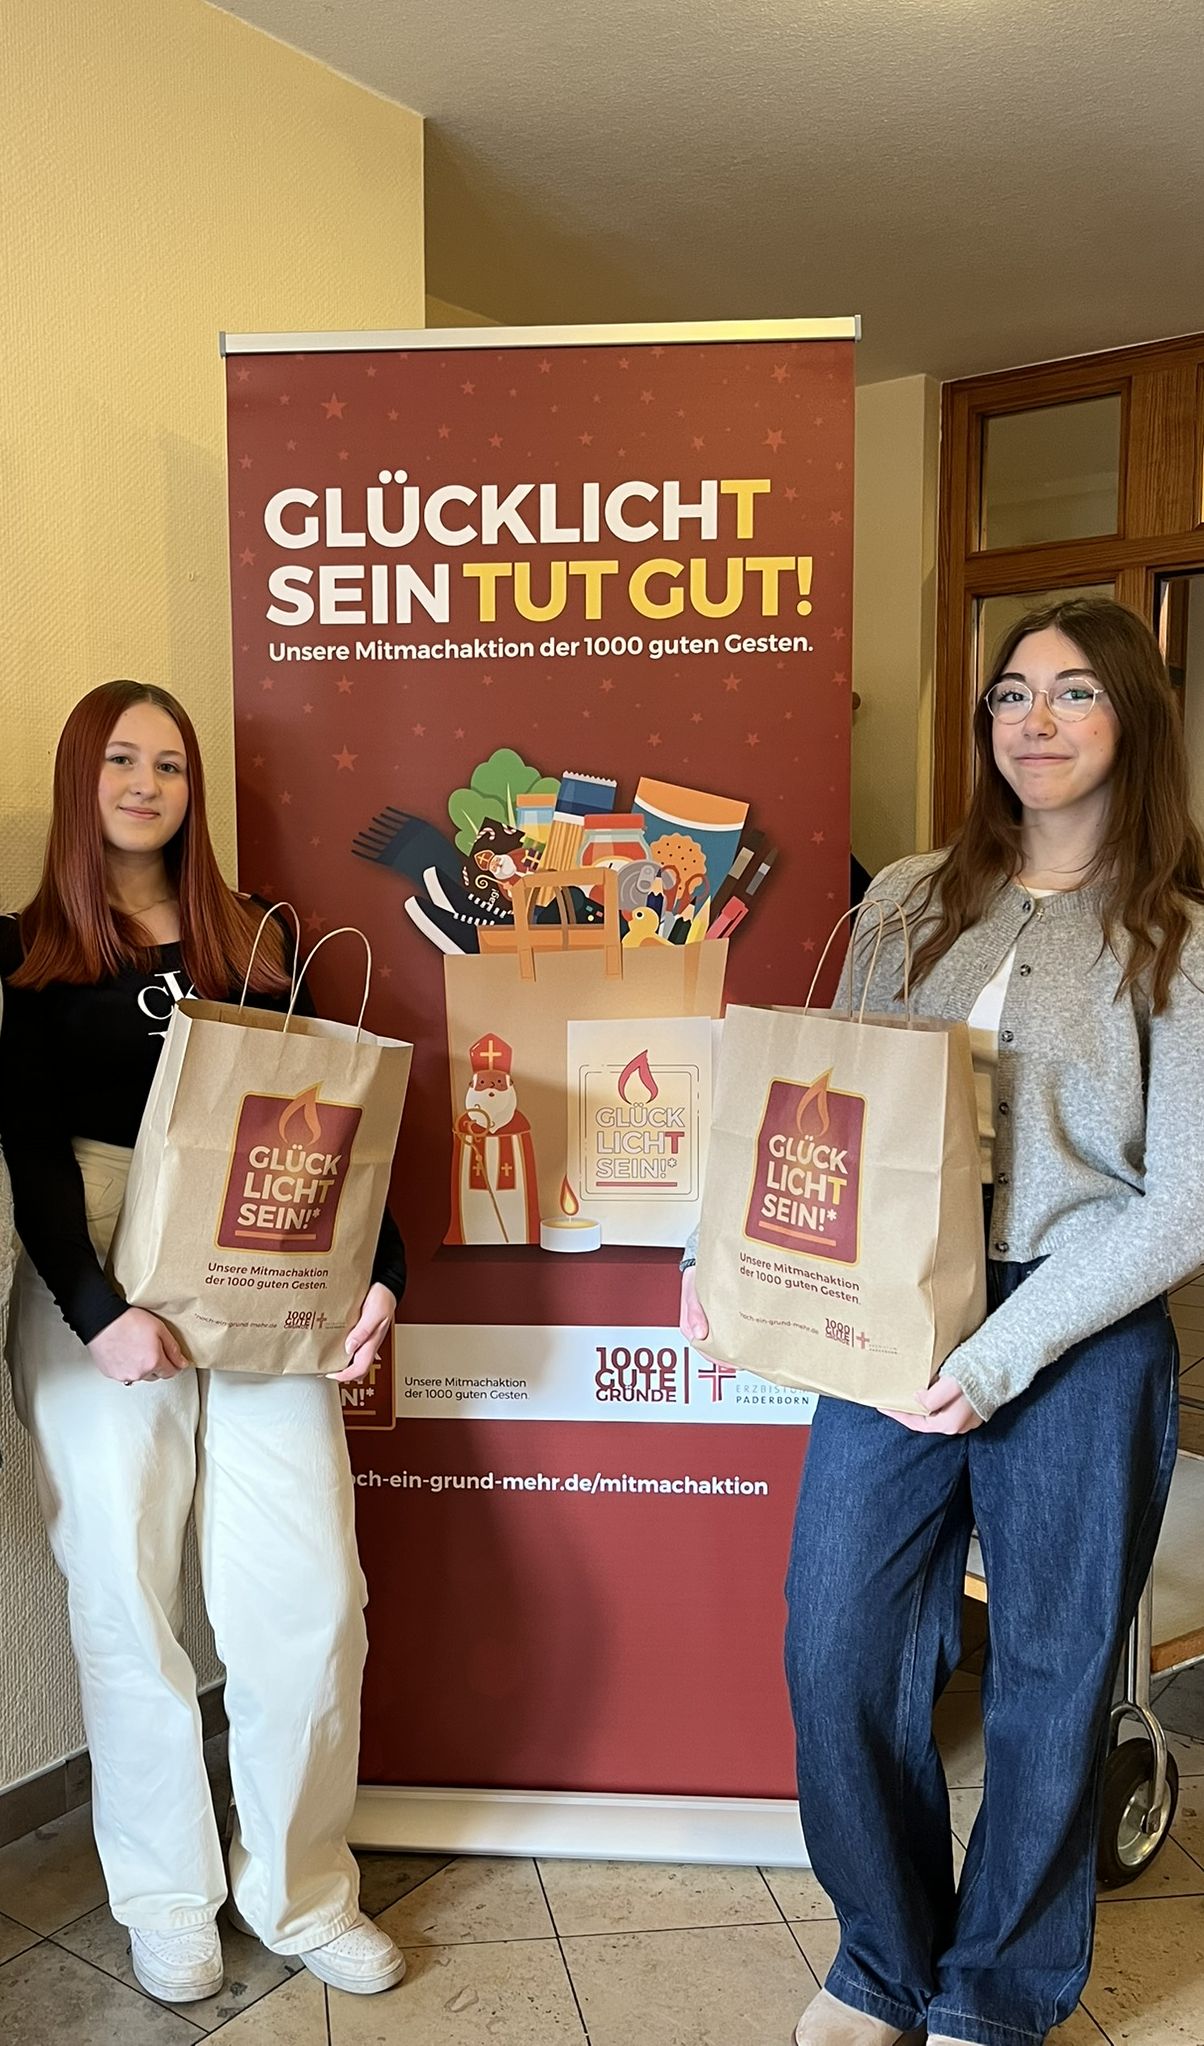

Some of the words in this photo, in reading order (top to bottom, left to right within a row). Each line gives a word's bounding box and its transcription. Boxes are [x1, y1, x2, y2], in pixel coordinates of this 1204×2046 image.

[264, 469, 771, 548] GLÜCKLICHT
[265, 563, 450, 626] SEIN
[463, 560, 618, 622] TUT
[629, 556, 814, 619] GUT!
[269, 642, 350, 662] Unsere
[355, 638, 534, 661] Mitmachaktion
[540, 637, 580, 658] der
[584, 637, 643, 657] 1000
[649, 636, 719, 660] guten
[725, 633, 814, 654] Gesten.
[595, 1102, 686, 1128] GLÜCK
[597, 1131, 685, 1154] LICHT
[248, 1143, 342, 1176] GLÜCK
[768, 1134, 849, 1175] GLÜCK
[243, 1172, 335, 1204] LICHT
[766, 1161, 847, 1206] LICHT
[208, 1262, 248, 1274] Unsere
[250, 1266, 329, 1277] Mitmachaktion
[740, 1252, 772, 1270] Unsere
[773, 1263, 860, 1291] Mitmachaktion
[205, 1275, 225, 1285] der
[227, 1276, 255, 1287] 1000
[257, 1280, 289, 1290] guten
[291, 1281, 328, 1290] Gesten.
[740, 1265, 754, 1278] der
[756, 1270, 782, 1285] 1000
[784, 1279, 818, 1292] guten
[820, 1286, 861, 1305] Gesten.
[288, 1311, 313, 1320] 1000
[825, 1317, 851, 1335] 1000
[596, 1347, 677, 1370] 1000
[404, 1376, 442, 1387] Unsere
[445, 1377, 527, 1387] Mitmachaktion
[595, 1369, 676, 1391] GUTE
[404, 1388, 422, 1398] der
[425, 1389, 453, 1399] 1000
[455, 1391, 487, 1400] guten
[596, 1385, 677, 1402] GRÜNDE
[736, 1396, 809, 1405] PADERBORN
